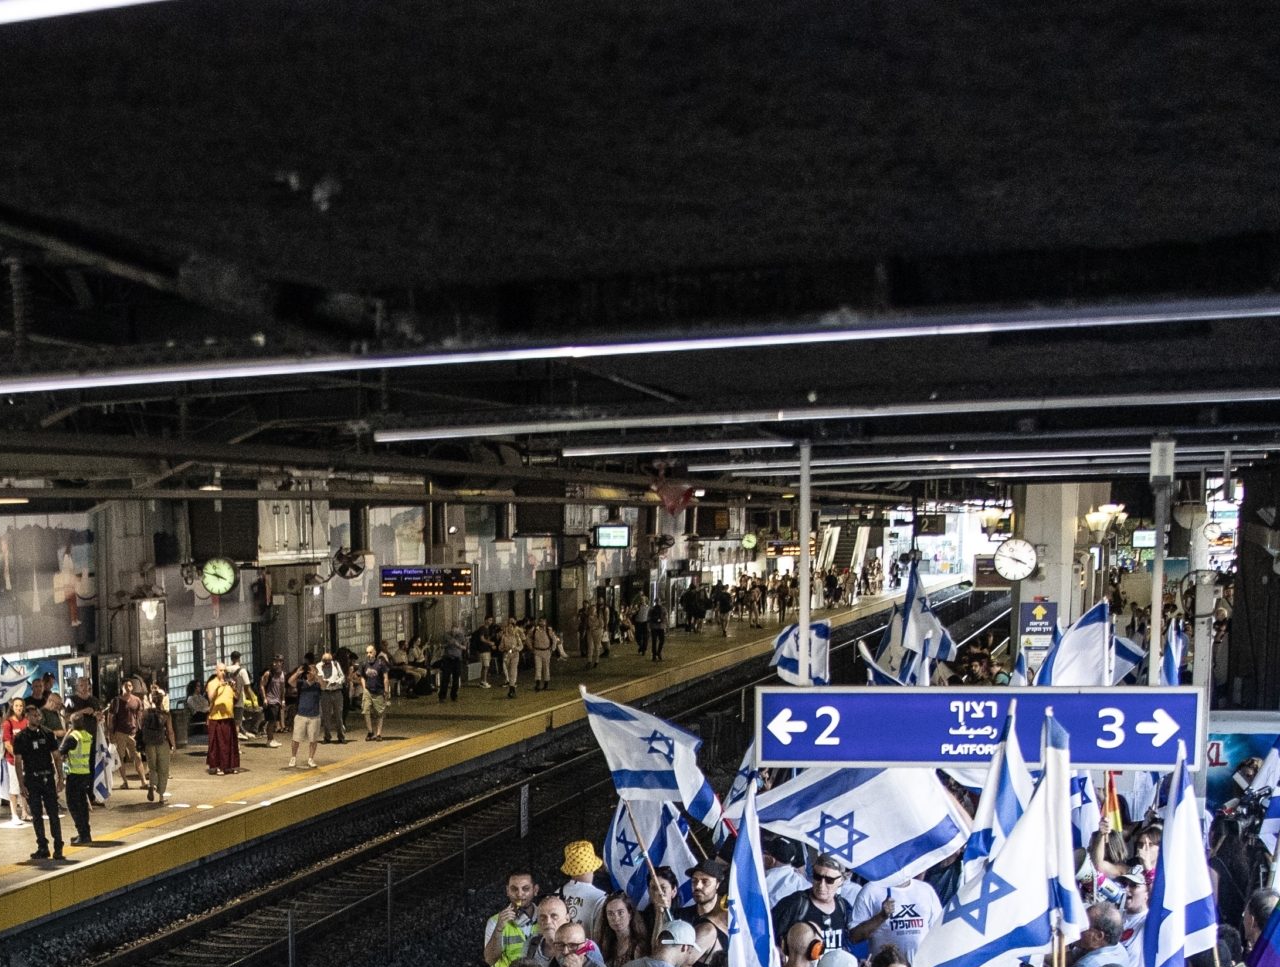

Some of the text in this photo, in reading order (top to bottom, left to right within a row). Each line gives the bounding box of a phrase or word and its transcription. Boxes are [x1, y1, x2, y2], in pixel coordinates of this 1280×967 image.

[950, 700, 998, 723] רציף
[814, 705, 841, 746] 2
[948, 721, 998, 739] رصيف
[1096, 707, 1126, 749] 3
[941, 743, 997, 756] PLATFOR
